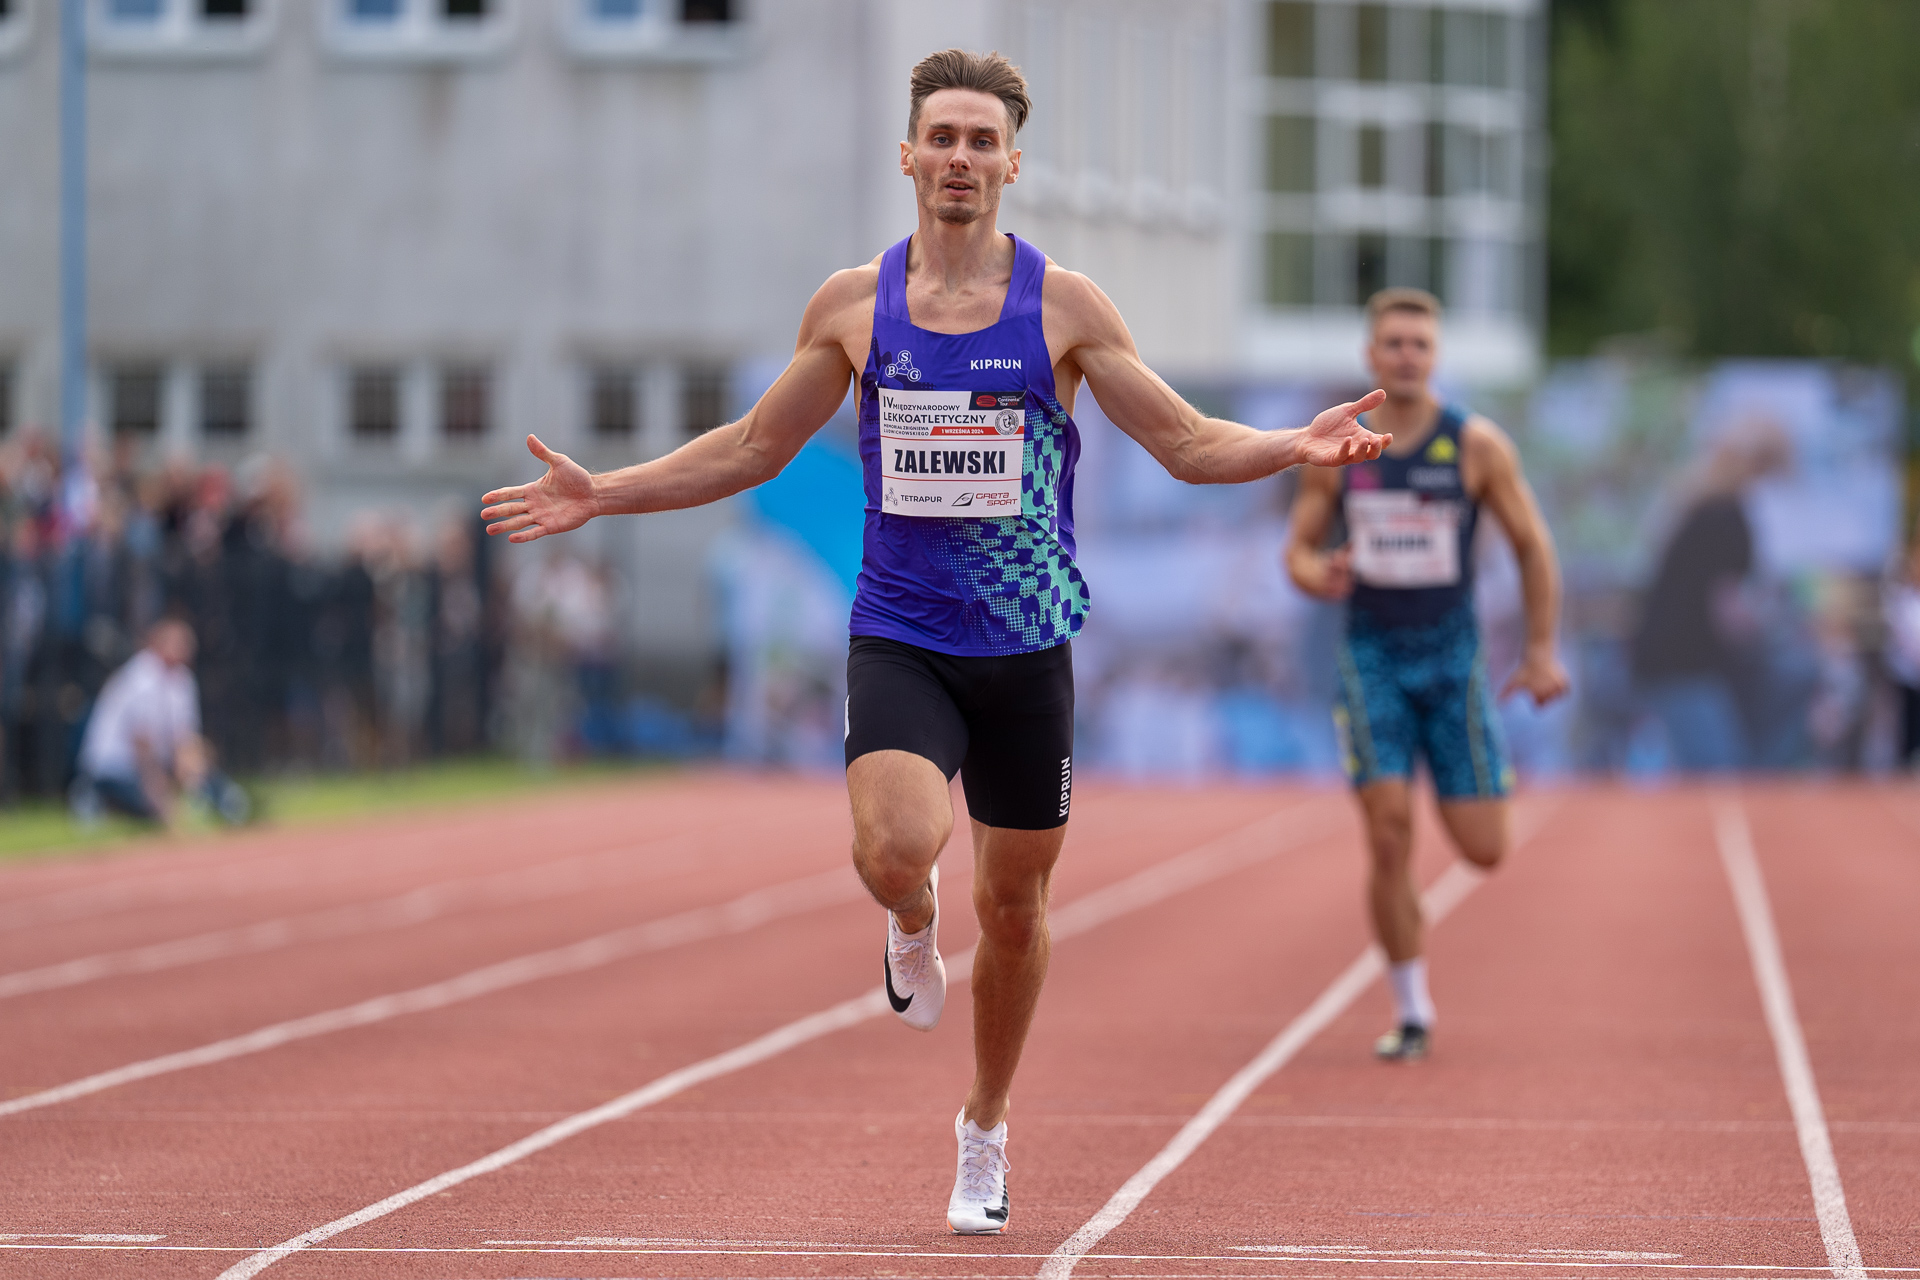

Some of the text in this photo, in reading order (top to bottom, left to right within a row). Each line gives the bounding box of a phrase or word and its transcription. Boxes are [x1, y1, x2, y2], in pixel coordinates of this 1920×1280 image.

[970, 359, 1022, 370] KIPRUN
[883, 396, 894, 408] IV
[883, 412, 986, 424] LEKKOATLETYCZNY
[894, 449, 1006, 474] ZALEWSKI
[900, 494, 943, 503] TETRAPUR
[986, 498, 1018, 506] SPORT
[1058, 756, 1071, 818] KIPRUN
